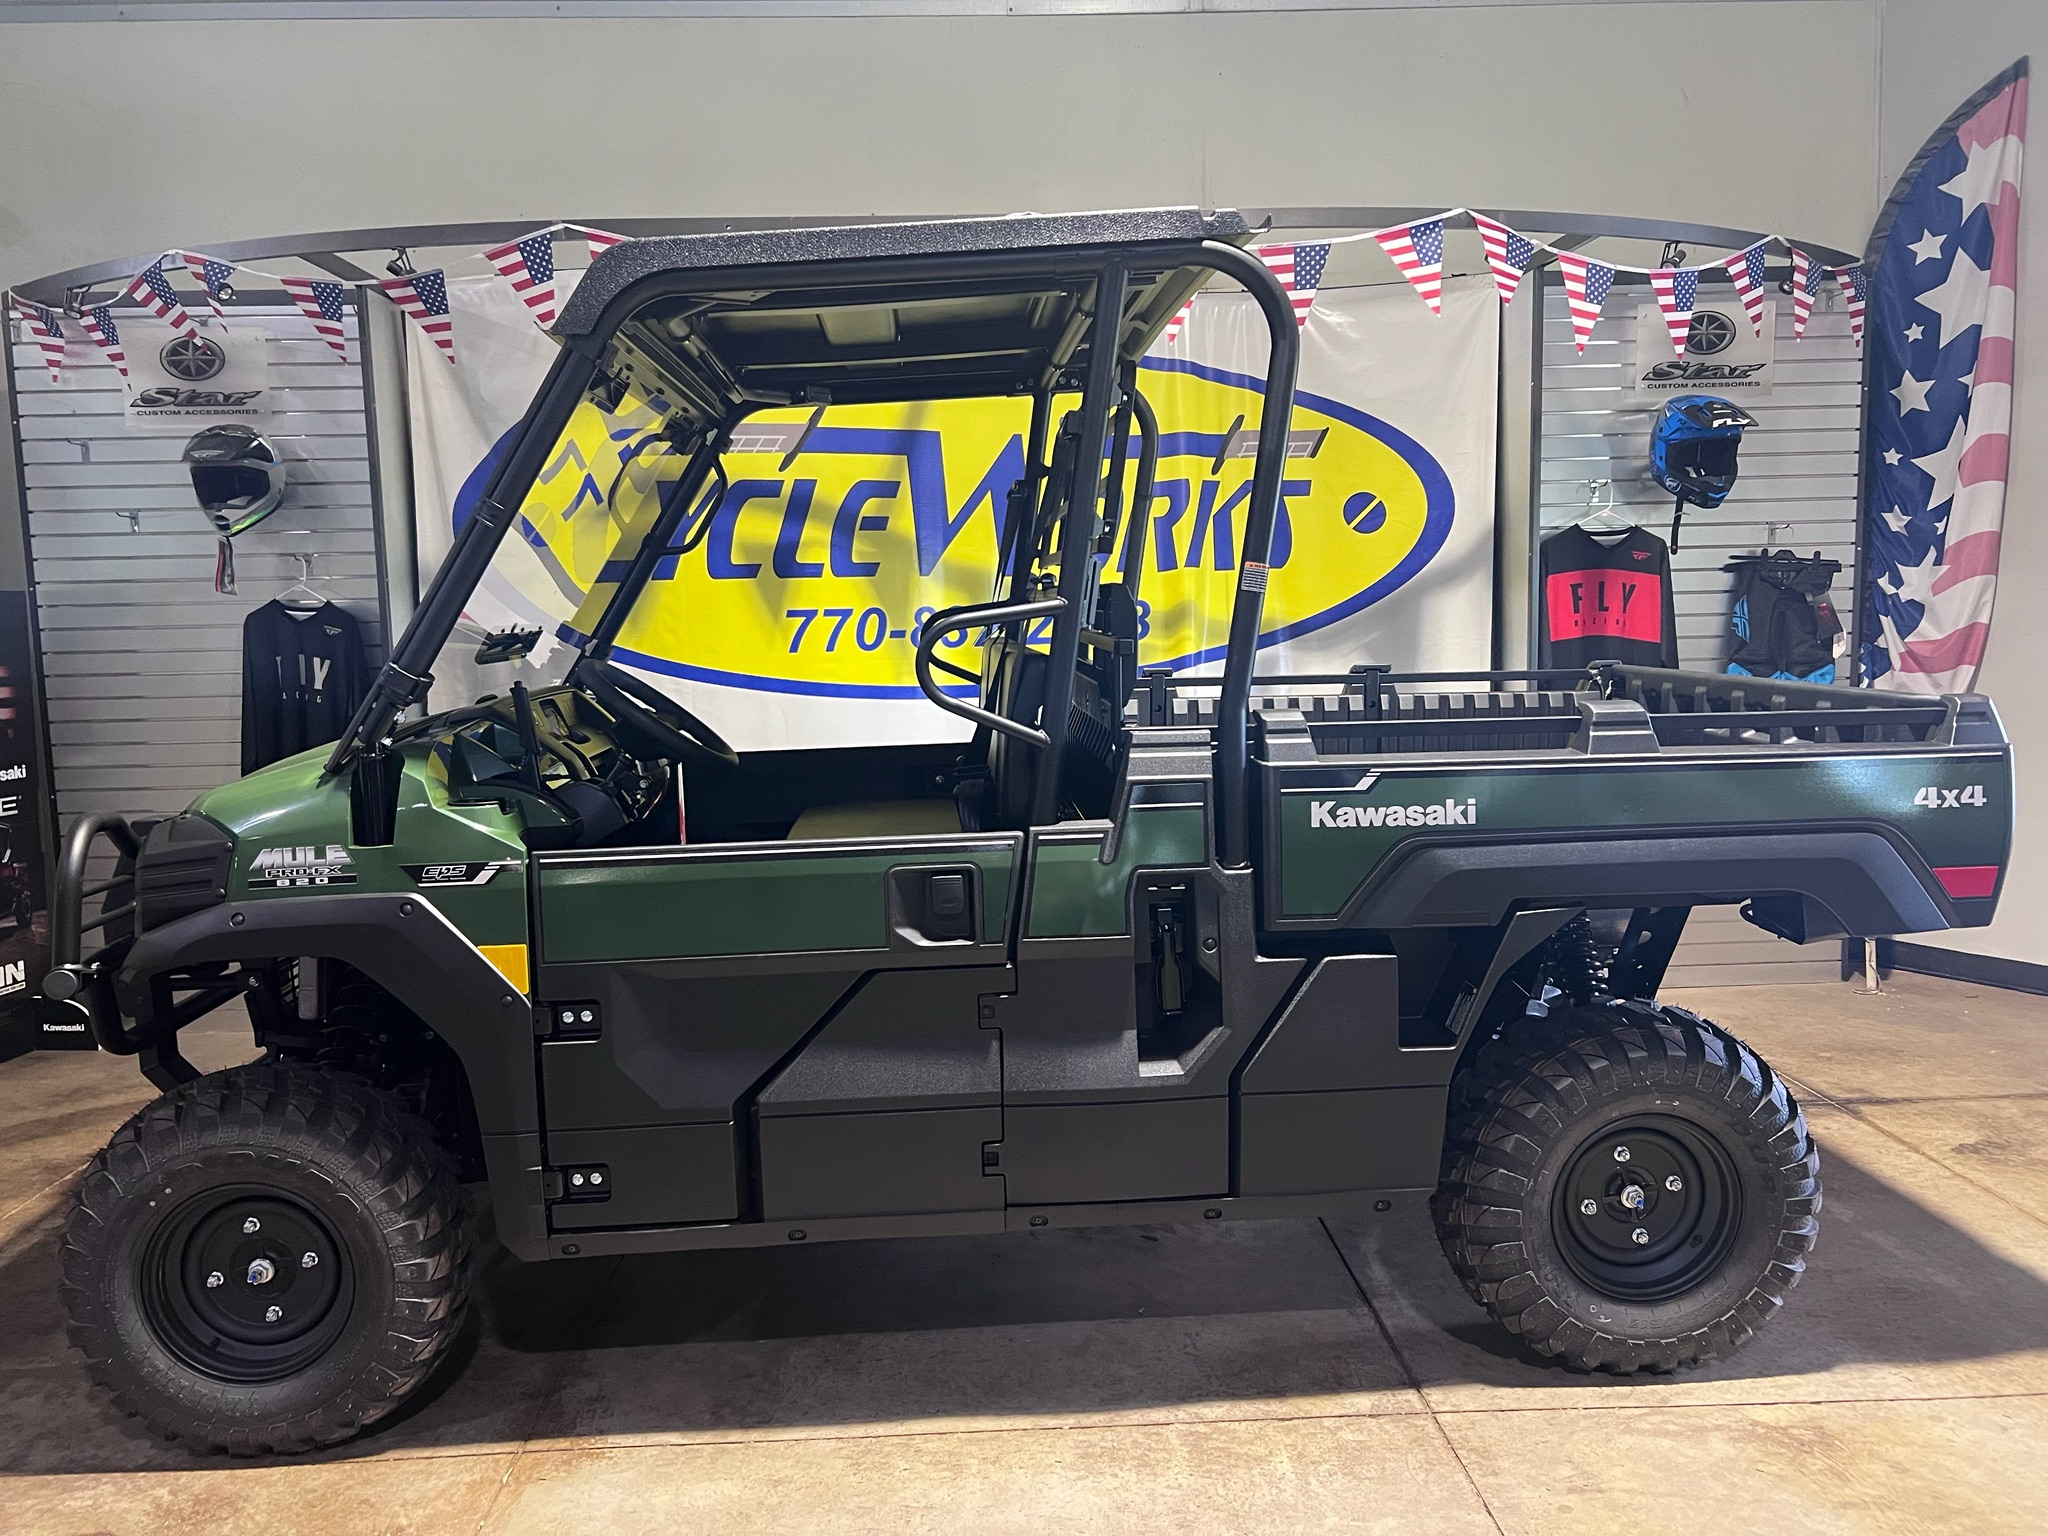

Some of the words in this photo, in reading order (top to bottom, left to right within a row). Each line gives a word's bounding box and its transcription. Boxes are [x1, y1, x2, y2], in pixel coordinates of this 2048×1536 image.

[1641, 361, 1767, 381] Star
[1692, 381, 1761, 389] ACCESSORIES
[129, 387, 263, 408] Star
[184, 408, 259, 416] ACCESSORIES
[1712, 417, 1751, 429] FLY
[1569, 581, 1637, 615] FLY
[1914, 785, 1987, 809] 4x4
[1310, 798, 1477, 829] Kawasaki
[249, 844, 356, 872] MULE
[276, 877, 329, 887] 820
[43, 1023, 85, 1032] Kawasaki
